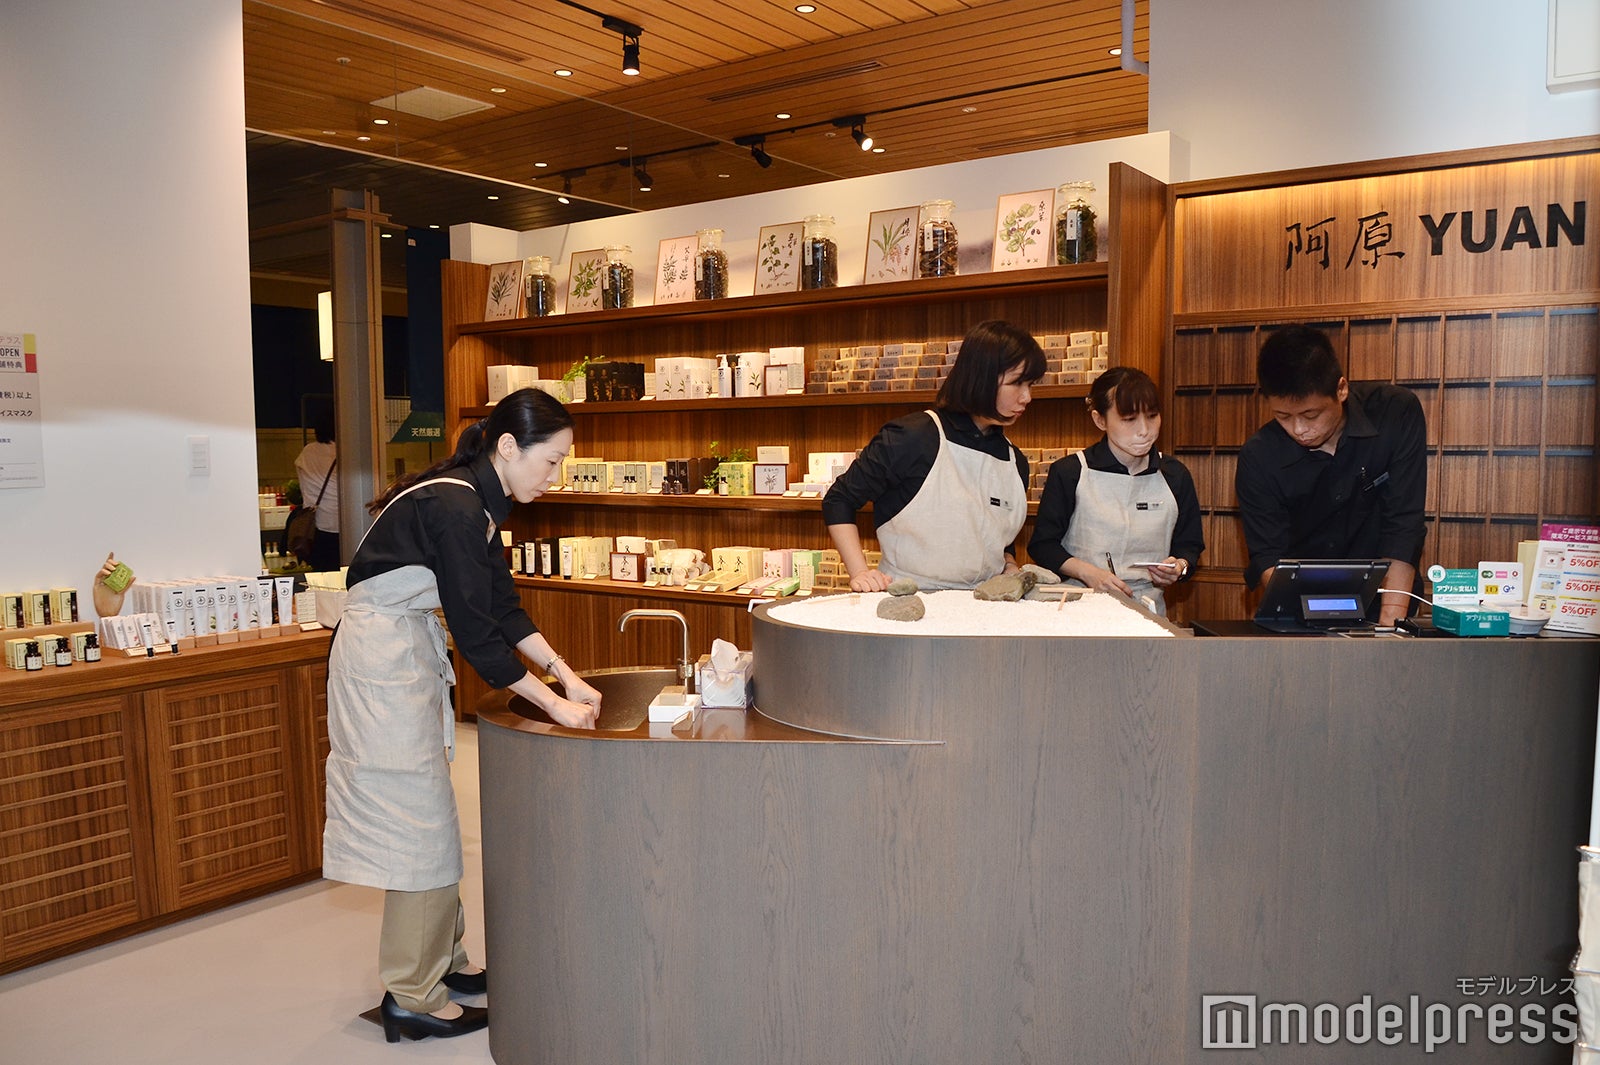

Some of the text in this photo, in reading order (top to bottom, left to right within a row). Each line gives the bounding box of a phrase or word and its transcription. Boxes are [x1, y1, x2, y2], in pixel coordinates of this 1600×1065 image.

[1285, 200, 1586, 271] 阿原 YUAN
[0, 347, 19, 357] OPEN
[0, 391, 32, 400] 税)以上
[1570, 558, 1600, 568] 5%OF
[1561, 605, 1598, 616] 5%OFF
